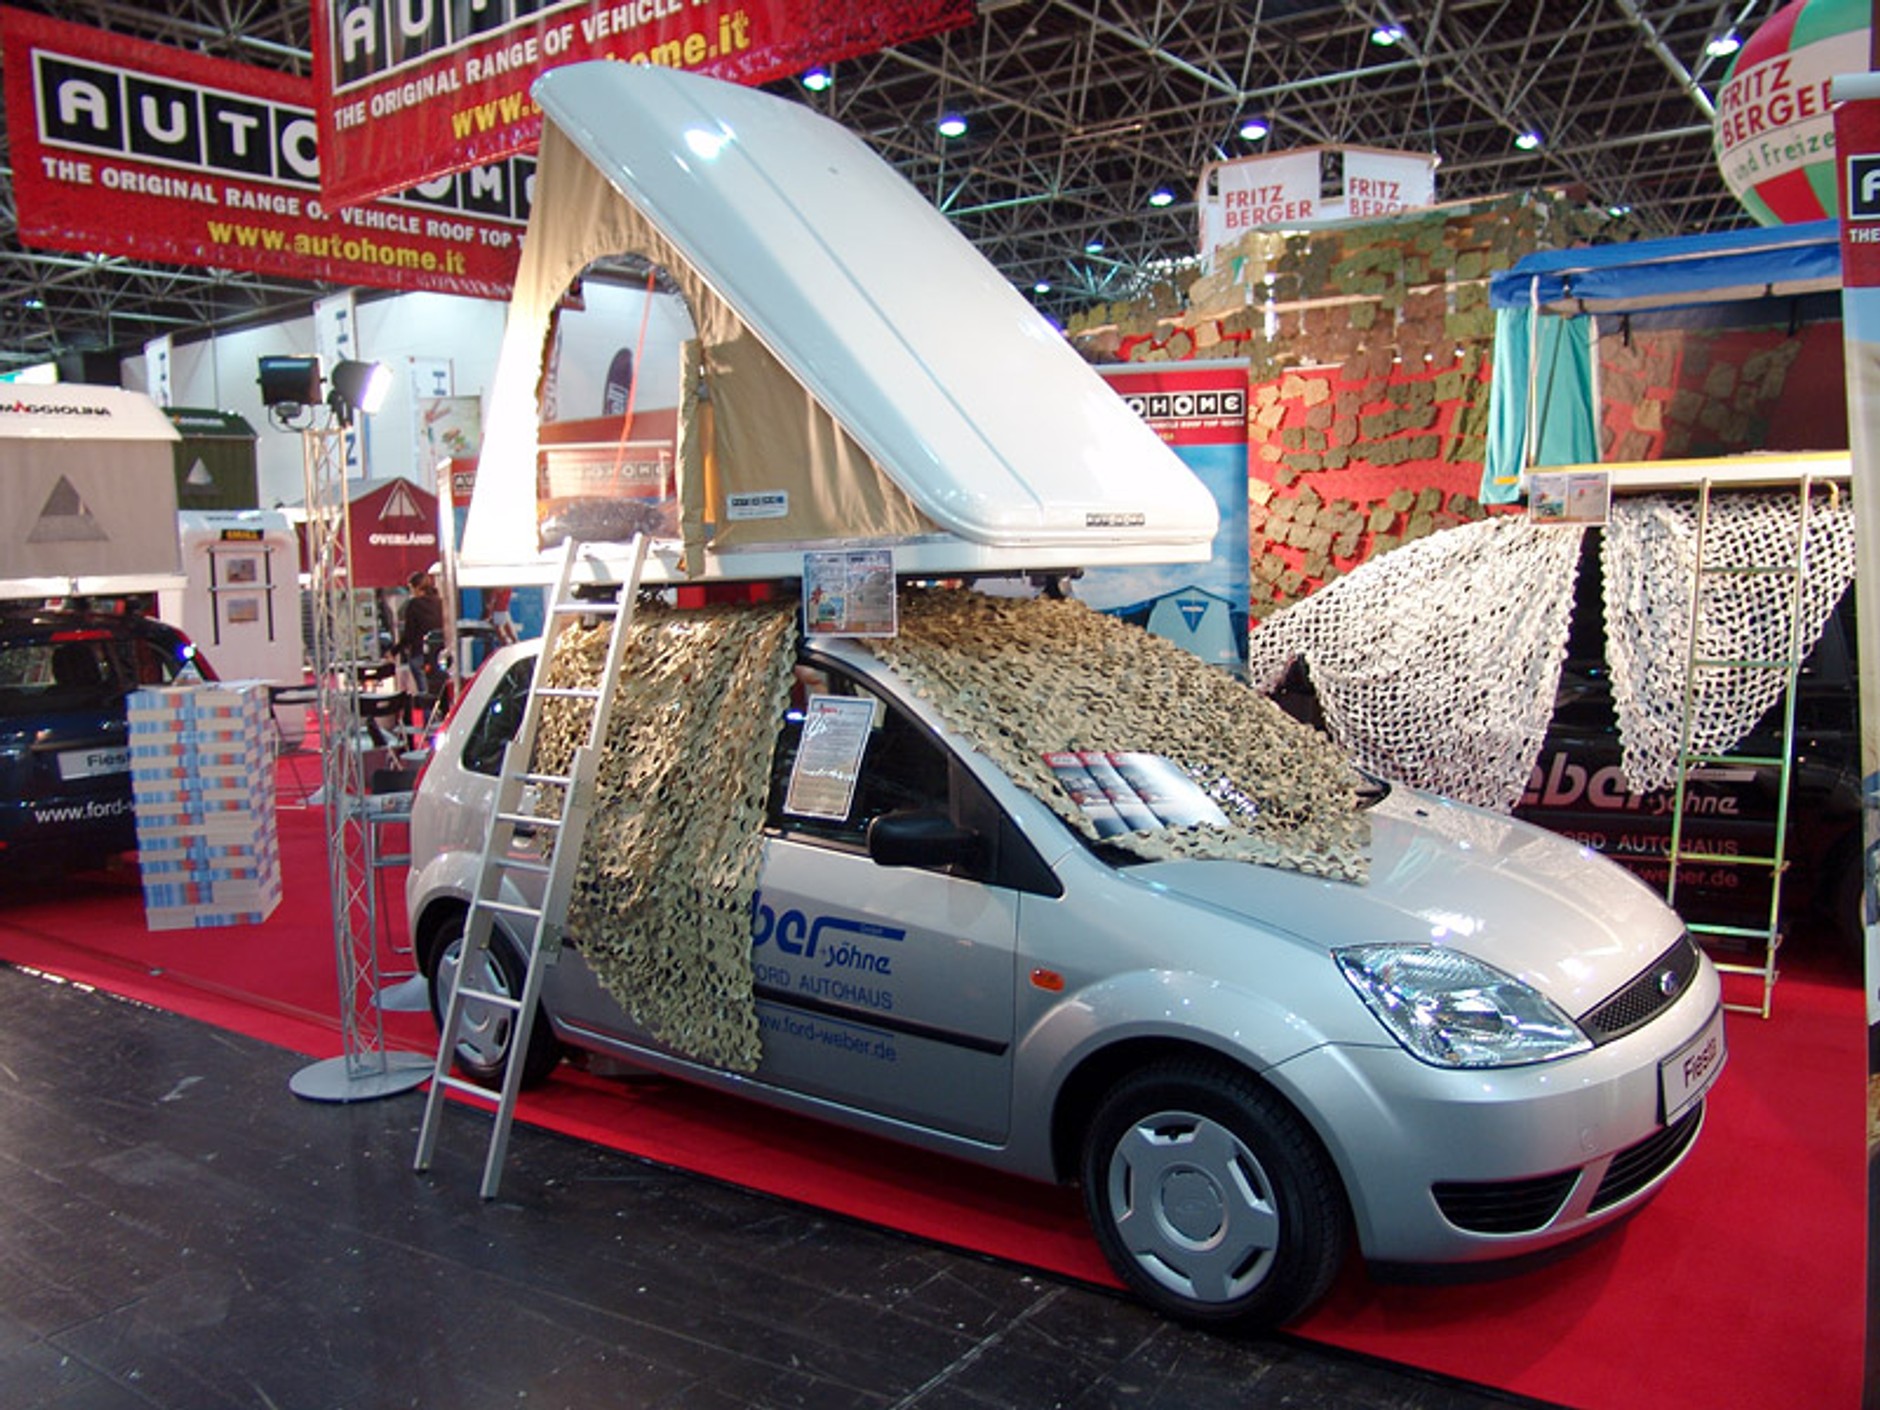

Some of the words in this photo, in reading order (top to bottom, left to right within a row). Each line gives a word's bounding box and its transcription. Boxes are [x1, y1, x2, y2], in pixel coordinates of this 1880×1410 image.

[334, 105, 366, 131] THE
[371, 72, 461, 117] ORIGINAL
[465, 39, 538, 84] RANGE
[544, 23, 574, 55] OF
[1721, 58, 1792, 116] FRITZ
[42, 157, 92, 184] THE
[102, 167, 218, 204] ORIGINAL
[225, 186, 299, 217] RANGE
[306, 200, 329, 220] O
[340, 206, 421, 234] VEHICLE
[427, 220, 474, 242] ROOF
[479, 229, 512, 249] TOP
[1225, 184, 1283, 208] FRITZ
[1349, 177, 1399, 199] FRITZ
[1226, 200, 1312, 228] BERGER
[1850, 228, 1880, 243] THE
[208, 220, 465, 275] www.autohome.it
[800, 974, 893, 1010] AUTOHAUS
[1683, 1037, 1718, 1088] Fiesta
